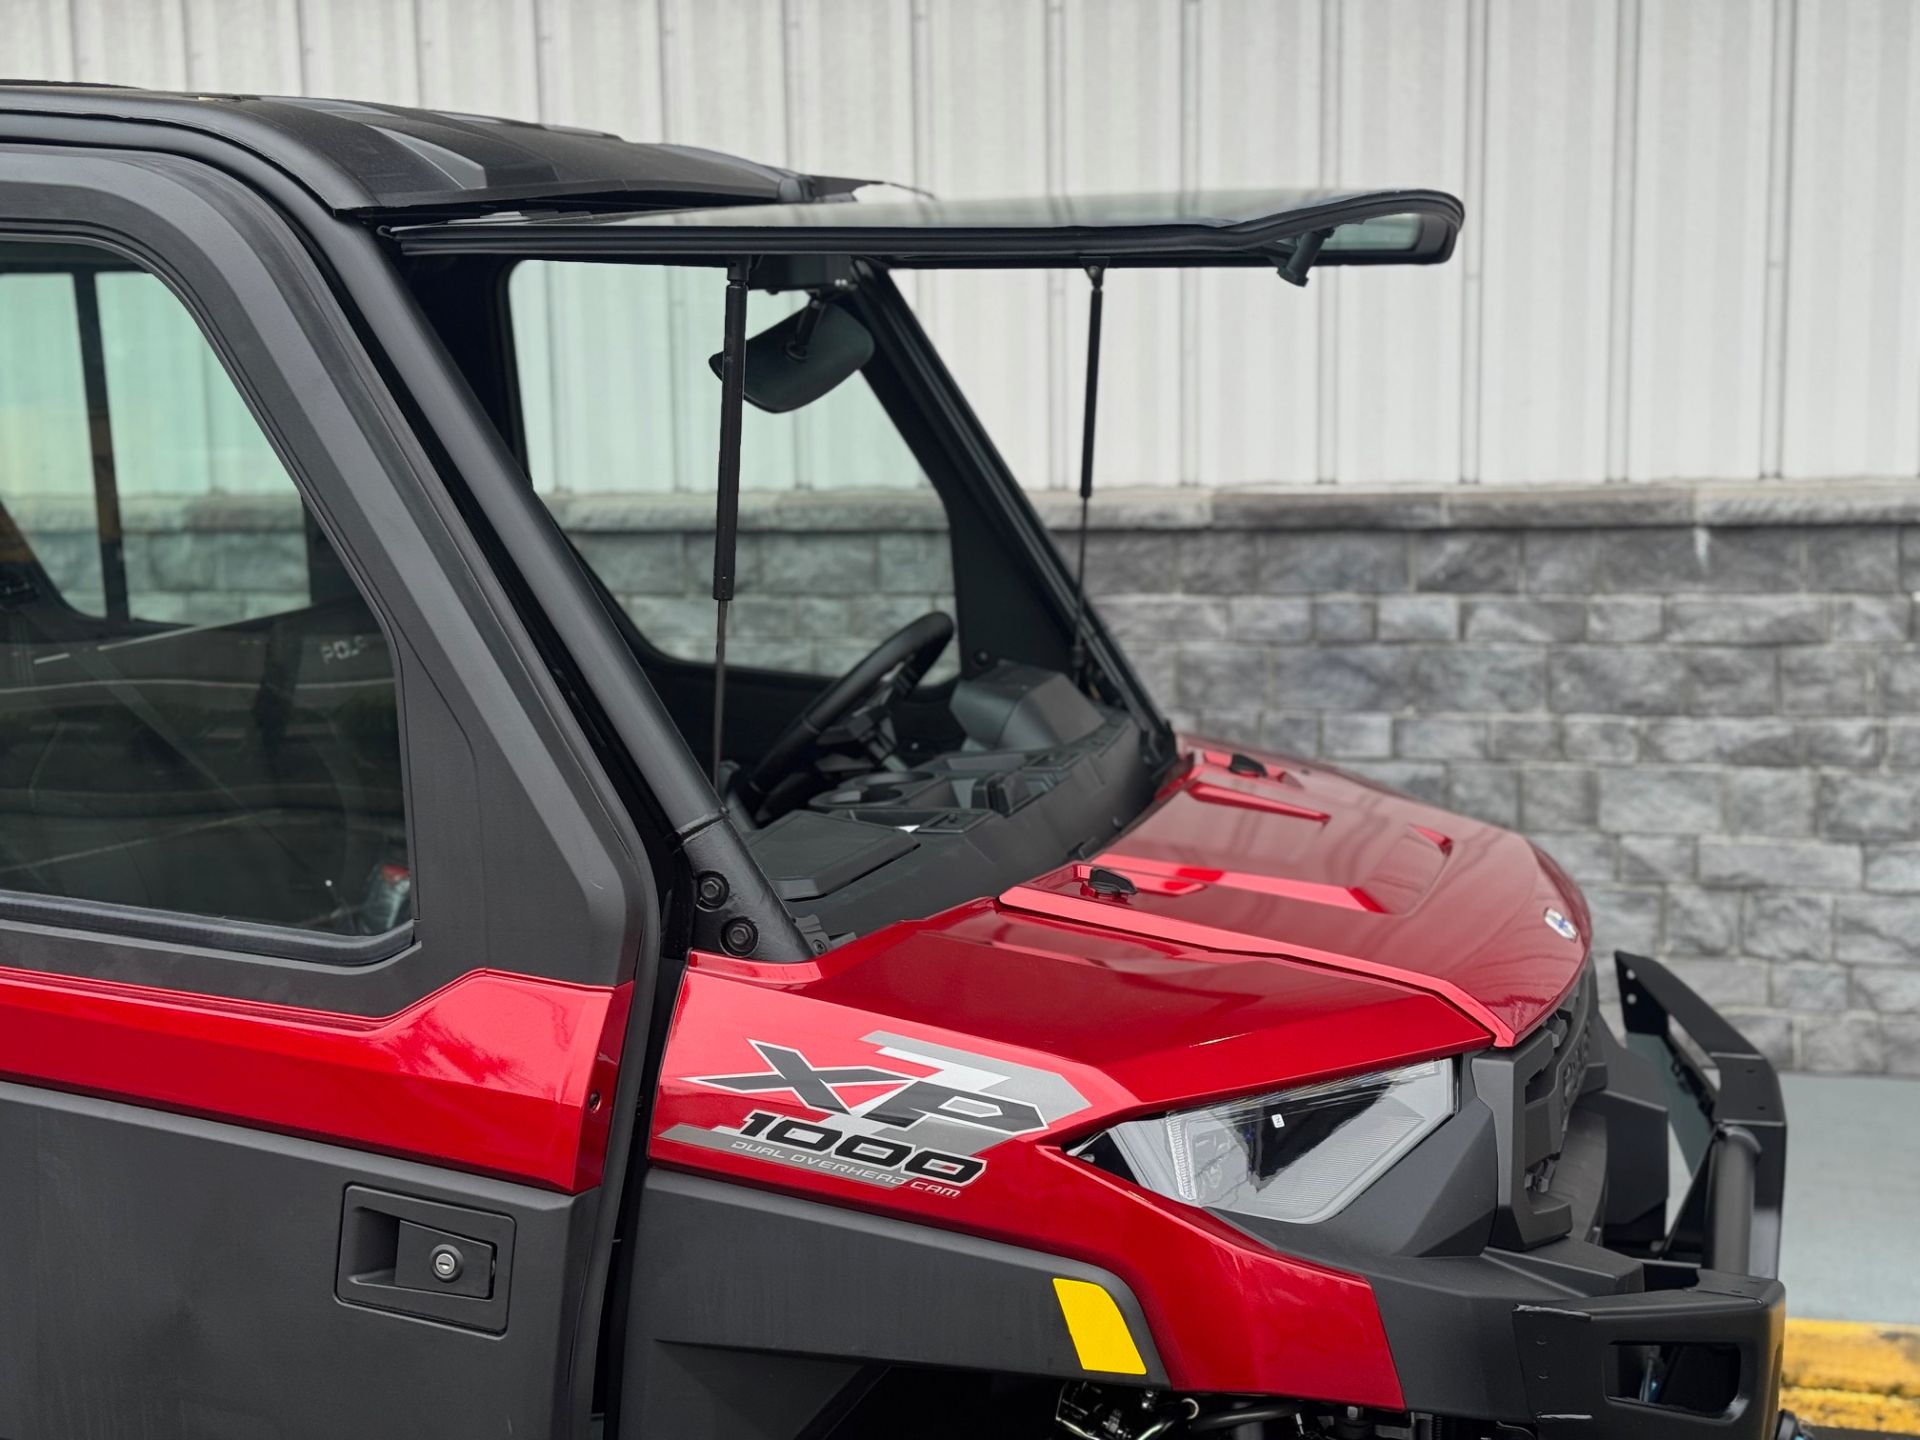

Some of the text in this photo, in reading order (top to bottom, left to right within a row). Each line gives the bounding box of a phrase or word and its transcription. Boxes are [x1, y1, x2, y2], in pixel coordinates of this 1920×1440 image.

[678, 1038, 1049, 1135] XP
[731, 1141, 961, 1198] DUAL OVERHEAD CAM
[739, 1110, 987, 1187] 1000
